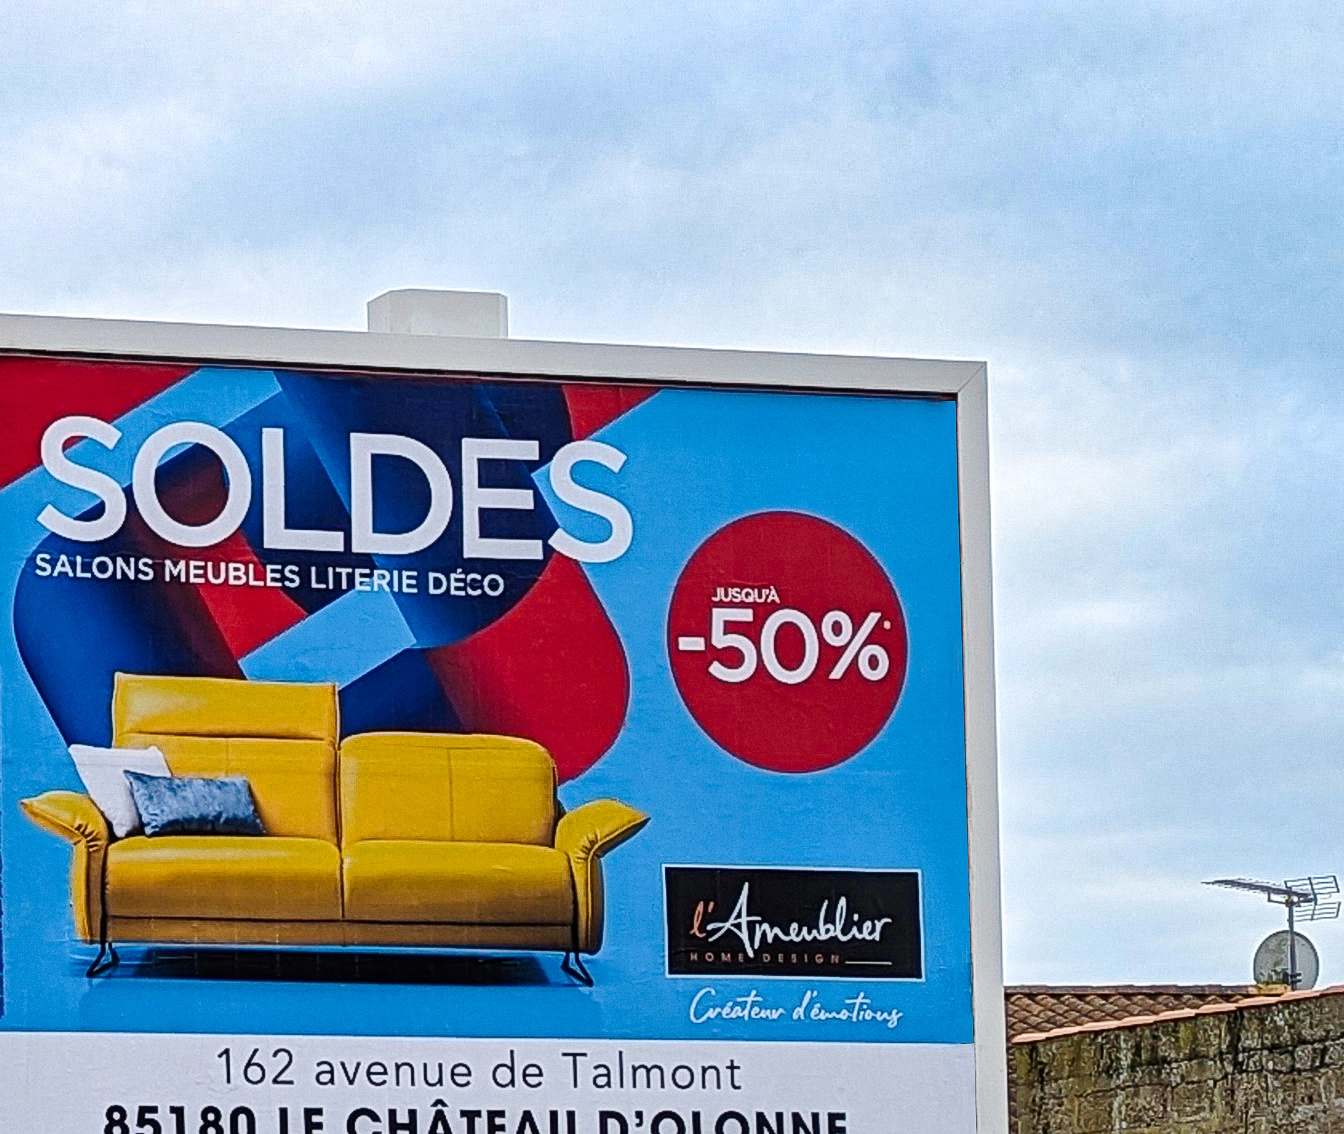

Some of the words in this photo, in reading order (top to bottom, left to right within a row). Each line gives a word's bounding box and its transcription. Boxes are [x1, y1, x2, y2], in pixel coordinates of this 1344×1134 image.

[37, 415, 634, 563] SOLDES
[35, 553, 154, 580] SALONS
[164, 560, 300, 588] MEUBLES
[311, 566, 417, 593] LITERIE
[428, 568, 504, 597] DÉCO
[711, 586, 781, 604] JUSQU'À
[689, 952, 744, 963] HOME
[762, 953, 840, 965] DESIGN
[689, 987, 787, 1024] Créateur
[792, 989, 904, 1029] d'émotions
[217, 1047, 294, 1086] 162
[315, 1059, 472, 1089] avenue
[491, 1049, 545, 1089] de
[561, 1050, 742, 1091] Talmont
